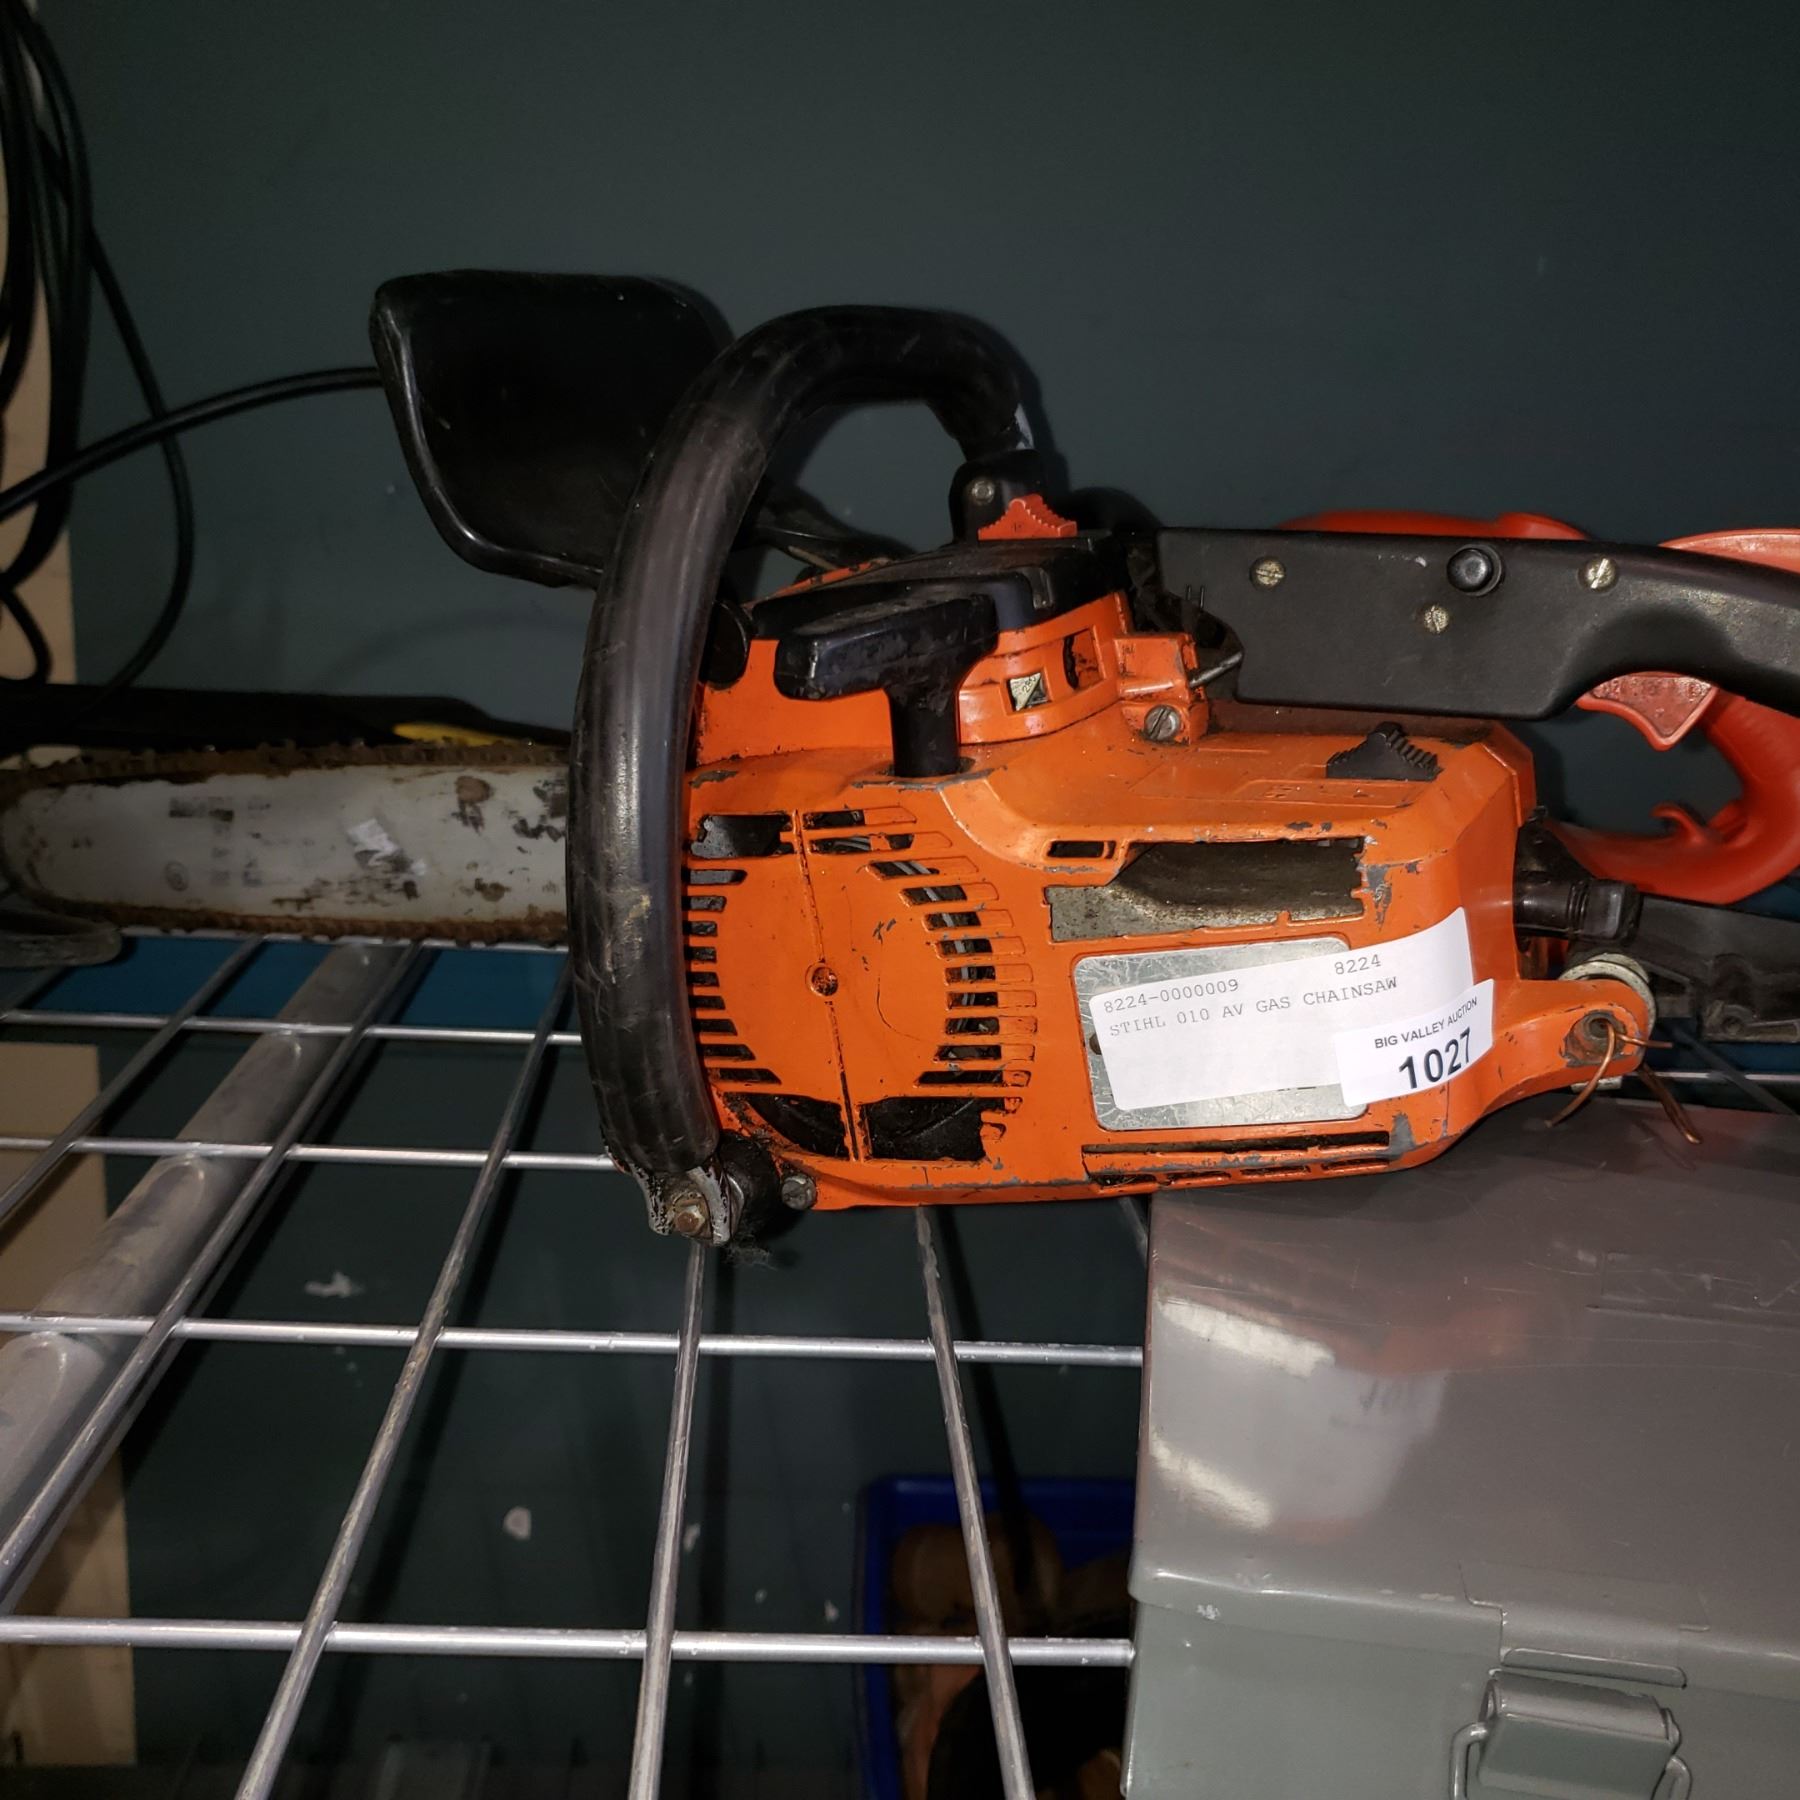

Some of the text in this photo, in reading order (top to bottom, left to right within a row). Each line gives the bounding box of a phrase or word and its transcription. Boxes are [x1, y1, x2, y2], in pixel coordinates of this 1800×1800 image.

[1334, 953, 1382, 976] 8224
[1103, 978, 1239, 1014] 8224-0000009
[1109, 976, 1398, 1037] STIHL 010 AV GAS CHAINSAW
[1374, 996, 1478, 1049] BIG VALLEY AUCTION
[1398, 1026, 1471, 1090] 1027
